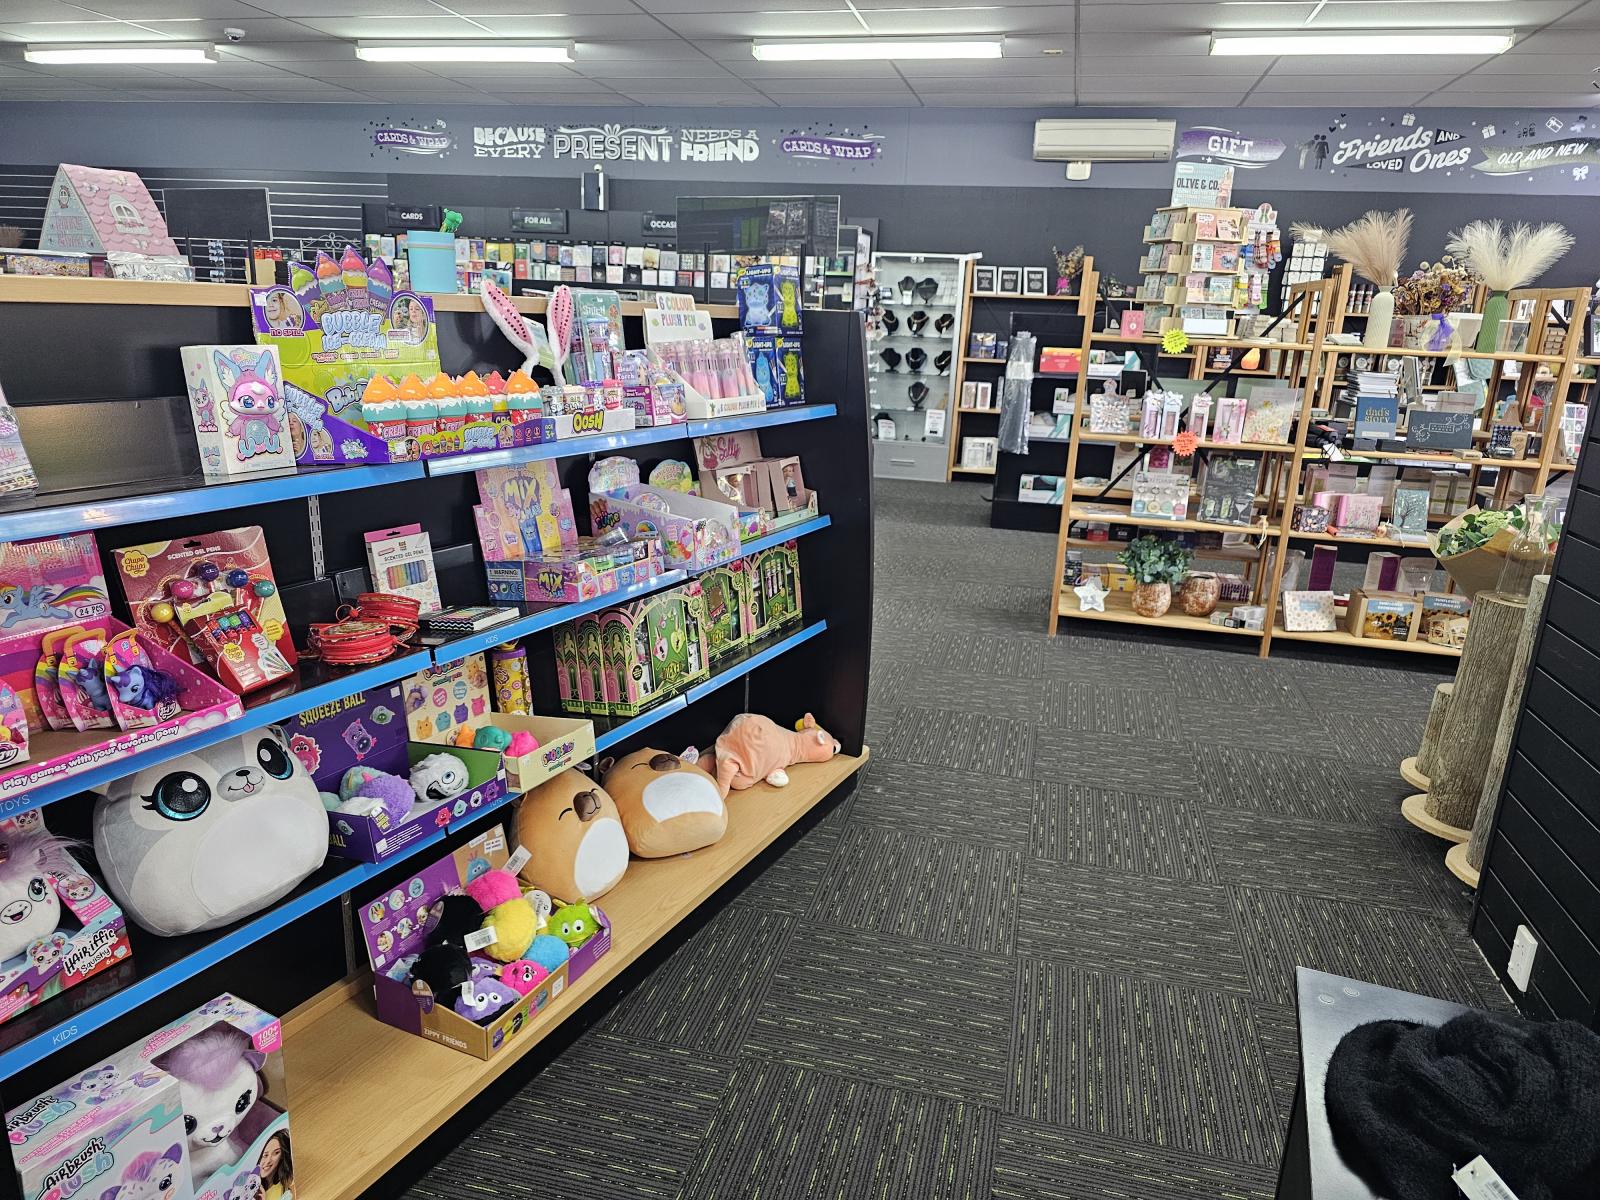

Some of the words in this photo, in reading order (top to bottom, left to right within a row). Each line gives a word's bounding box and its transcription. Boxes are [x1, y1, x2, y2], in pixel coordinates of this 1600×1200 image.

[377, 132, 409, 144] CARDS
[409, 134, 416, 145] &
[418, 136, 449, 148] WRAP
[474, 127, 546, 145] BECAUSE
[681, 129, 742, 141] NEEDS
[743, 129, 760, 141] A
[474, 142, 545, 158] EVERY
[553, 134, 673, 162] PRESENT
[680, 138, 760, 163] FRIEND
[783, 140, 823, 153] CARDS
[822, 144, 831, 154] &
[832, 146, 872, 159] WRAP
[1208, 135, 1255, 158] GIFT
[1333, 129, 1435, 165] Friends
[1437, 132, 1460, 144] AND
[1497, 149, 1523, 165] OLD
[1525, 146, 1553, 162] AND
[1556, 142, 1589, 160] NEW
[1366, 157, 1404, 171] LOVED
[1410, 146, 1472, 173] Ones
[1176, 177, 1199, 190] OLIVE
[1200, 179, 1207, 190] &
[1208, 180, 1220, 191] CO.
[401, 212, 424, 221] CARDS
[524, 216, 537, 225] FOR
[538, 217, 552, 225] ALL
[660, 300, 665, 311] 6
[667, 296, 695, 311] COLOUR
[321, 310, 383, 336] BUBBLE
[573, 409, 604, 433] OOSH
[1364, 415, 1390, 424] story
[1366, 407, 1390, 417] dad's
[505, 479, 538, 505] MIX
[167, 551, 194, 561] SCENTED
[194, 548, 205, 556] GEL
[205, 545, 221, 554] PENS
[79, 607, 90, 617] 24
[91, 605, 105, 614] PCS
[300, 698, 344, 727] SQUEEZE
[343, 691, 366, 711] BALL
[2, 775, 29, 791] Play
[30, 763, 67, 783] games
[68, 753, 92, 769] with
[93, 746, 117, 762] your
[117, 733, 155, 752] favorite
[155, 725, 180, 741] pony
[52, 1025, 78, 1045] KIDS
[424, 1028, 440, 1039] ZIPPY
[442, 1034, 468, 1049] FRIENDS
